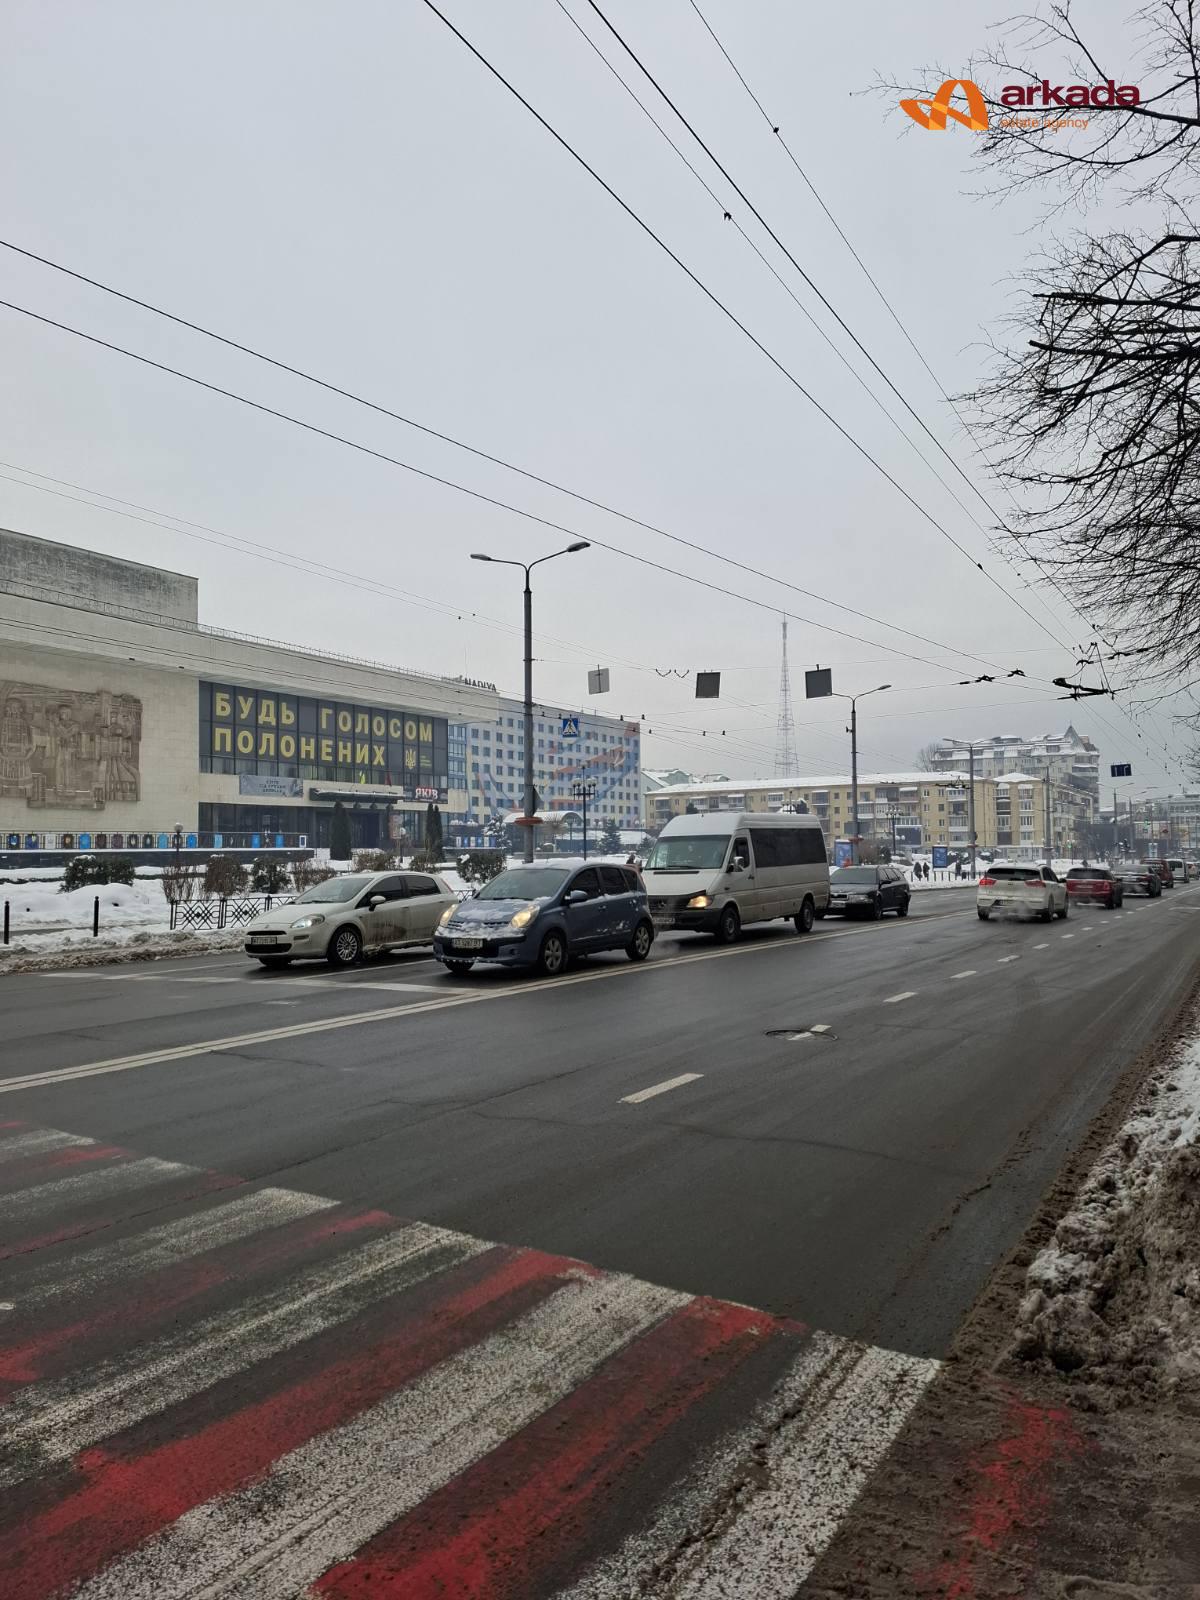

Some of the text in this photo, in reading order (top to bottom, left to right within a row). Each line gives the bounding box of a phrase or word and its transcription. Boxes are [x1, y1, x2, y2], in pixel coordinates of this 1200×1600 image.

[214, 691, 433, 743] БУДЬ ГОЛОСОМ
[214, 727, 385, 766] ПОЛОНЕНИХ
